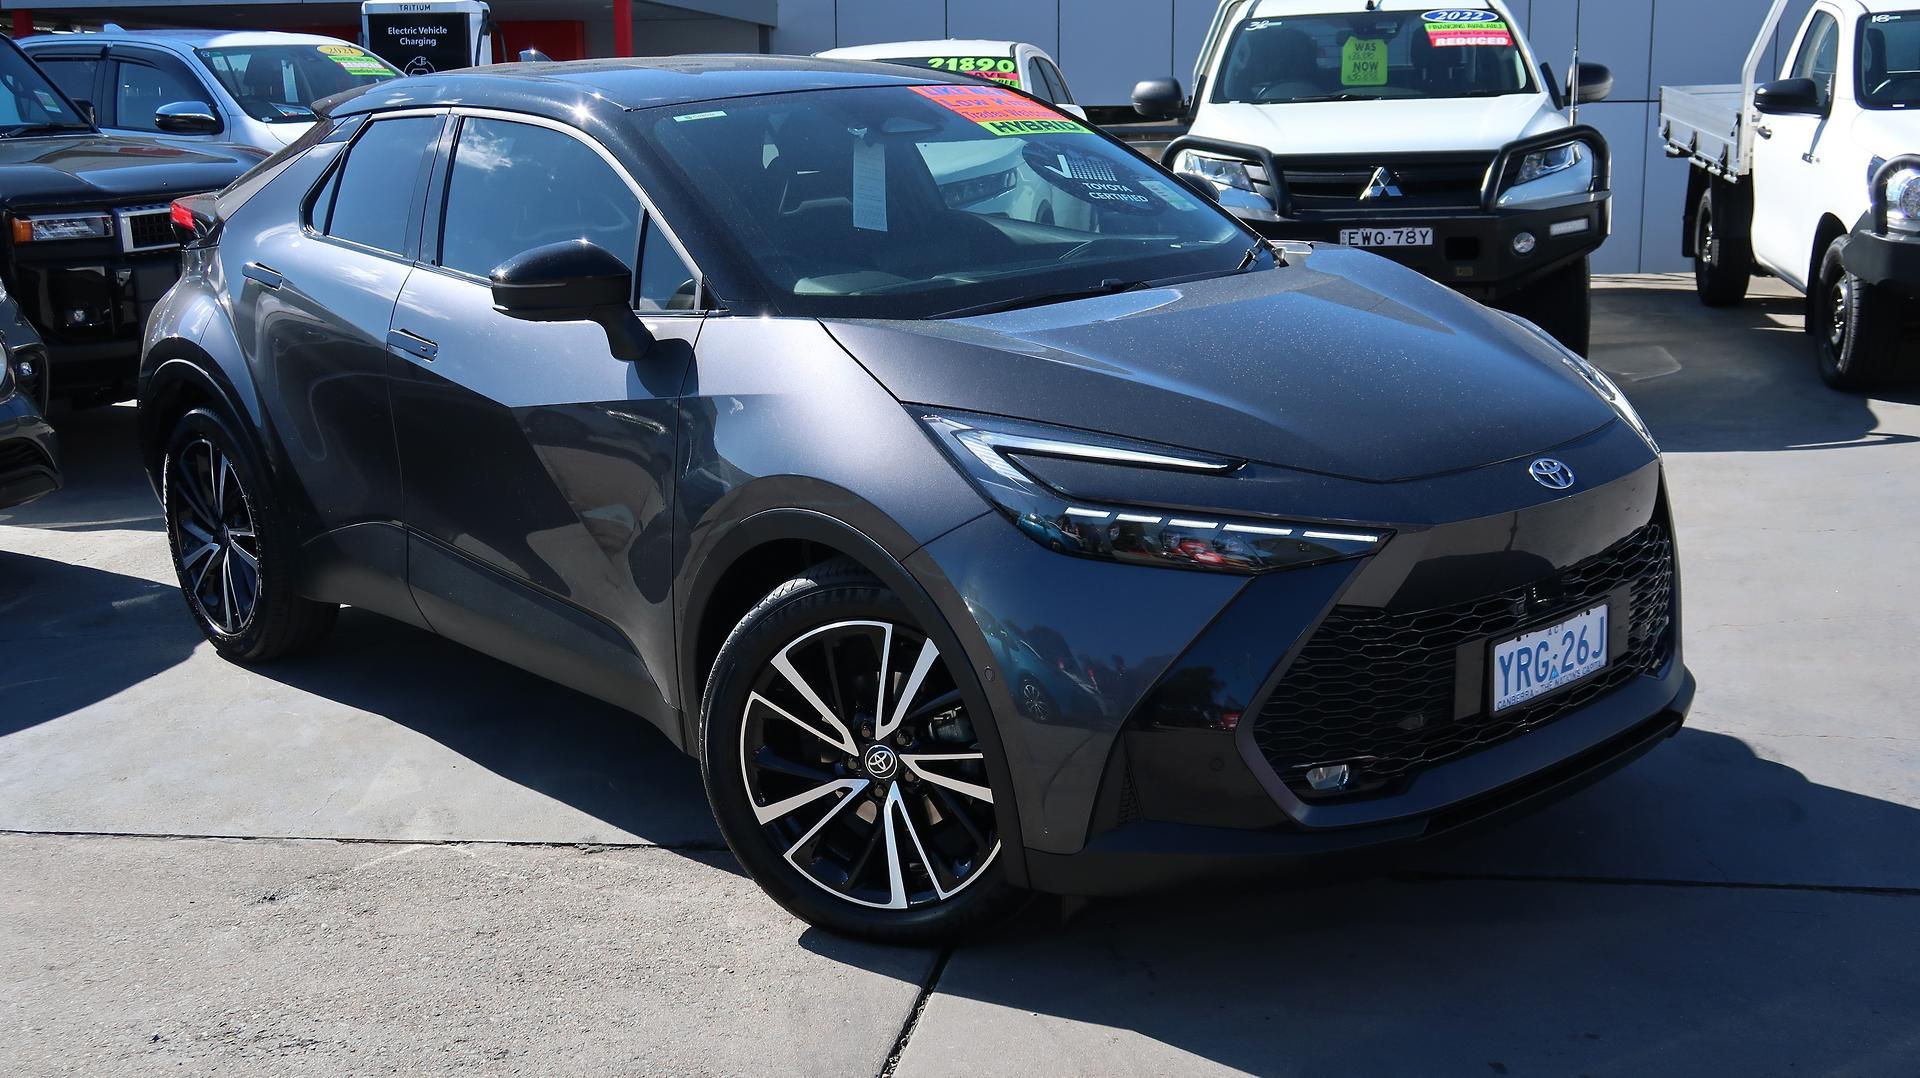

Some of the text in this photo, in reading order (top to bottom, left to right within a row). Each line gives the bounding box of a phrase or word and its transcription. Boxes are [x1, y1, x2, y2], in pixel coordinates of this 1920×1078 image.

[1437, 11, 1484, 20] 2022
[387, 26, 448, 35] Electric Vehicle
[400, 37, 437, 46] Charging
[1355, 42, 1376, 51] WAS
[1435, 37, 1509, 47] REDUCED
[1353, 61, 1379, 71] NOW
[989, 120, 1085, 134] HYBRID
[1082, 182, 1132, 192] TOYOTA
[1089, 192, 1148, 202] CERTIFIED
[1497, 690, 1534, 710] CANBERRA
